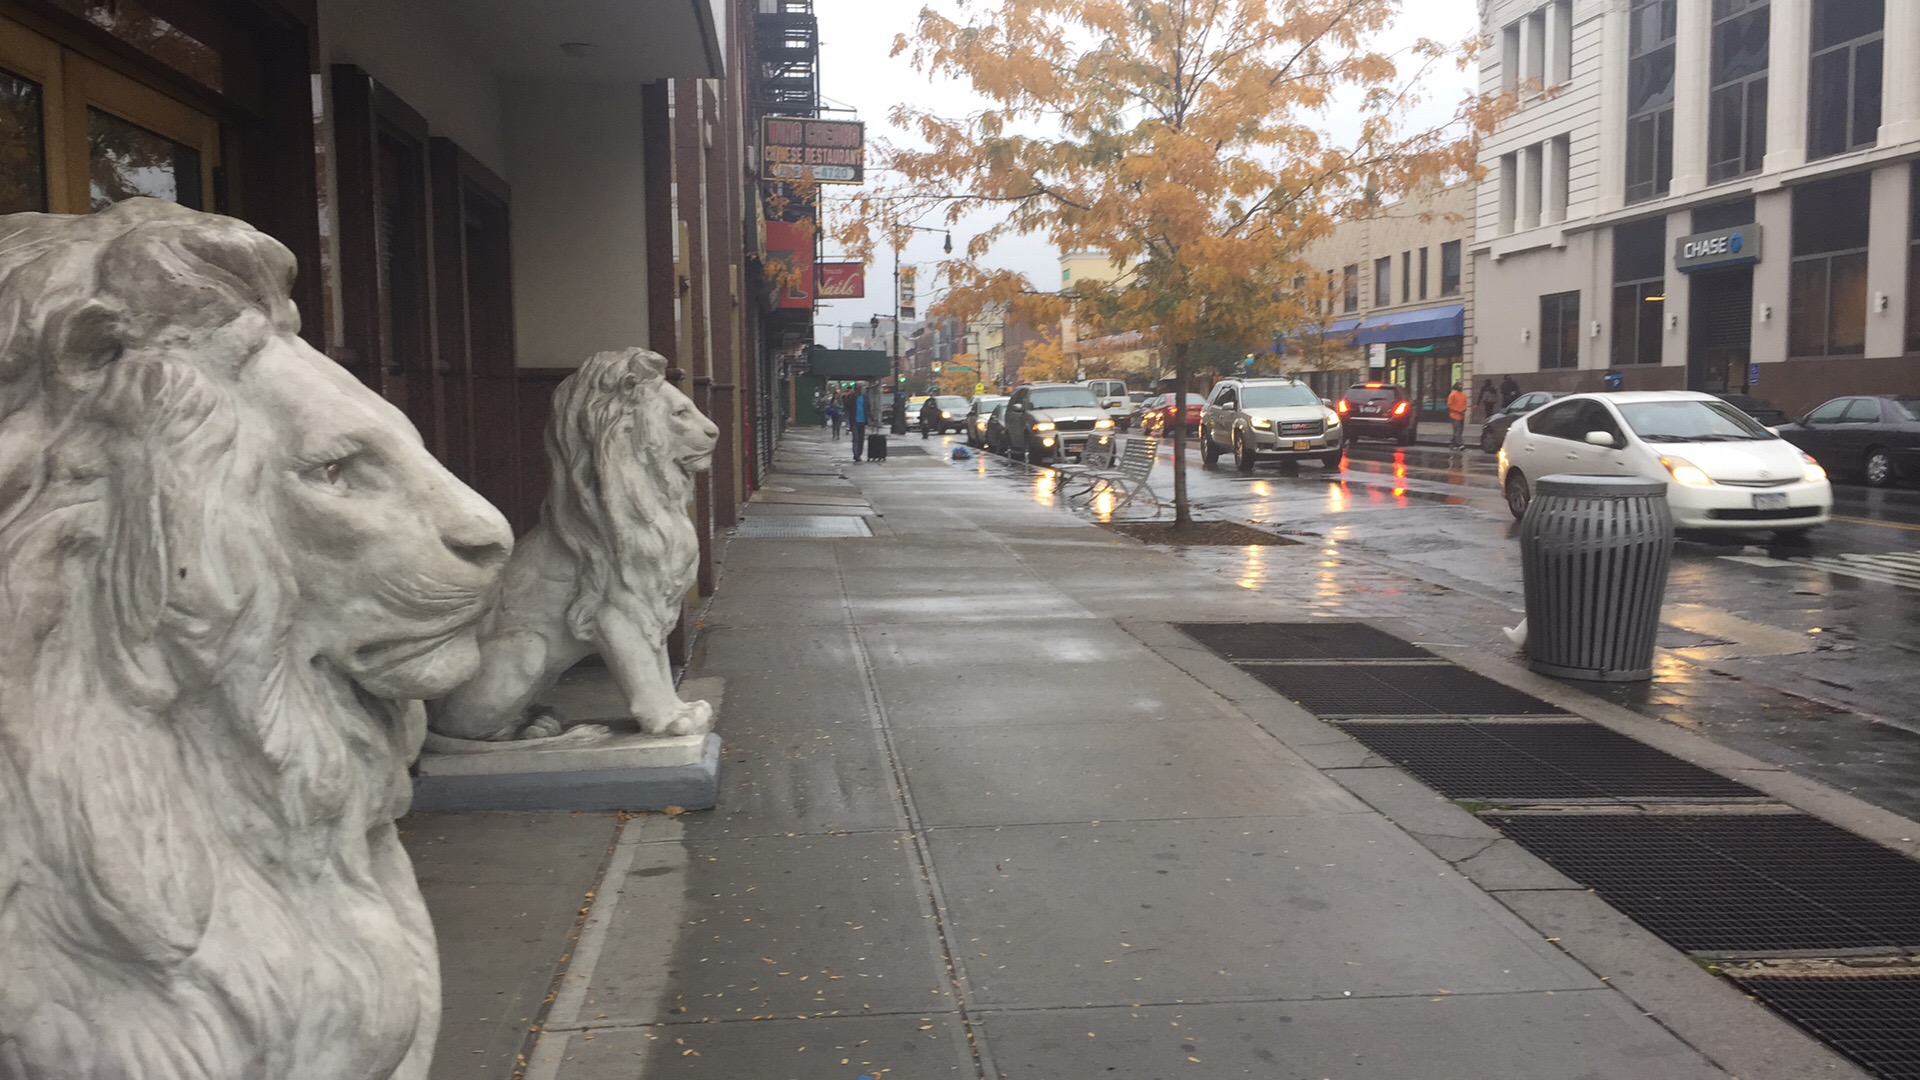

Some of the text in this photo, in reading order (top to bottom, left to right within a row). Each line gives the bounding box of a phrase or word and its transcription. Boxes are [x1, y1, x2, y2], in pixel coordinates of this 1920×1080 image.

[765, 145, 862, 165] CHESE RESTAURANT
[1684, 236, 1728, 258] CHASE
